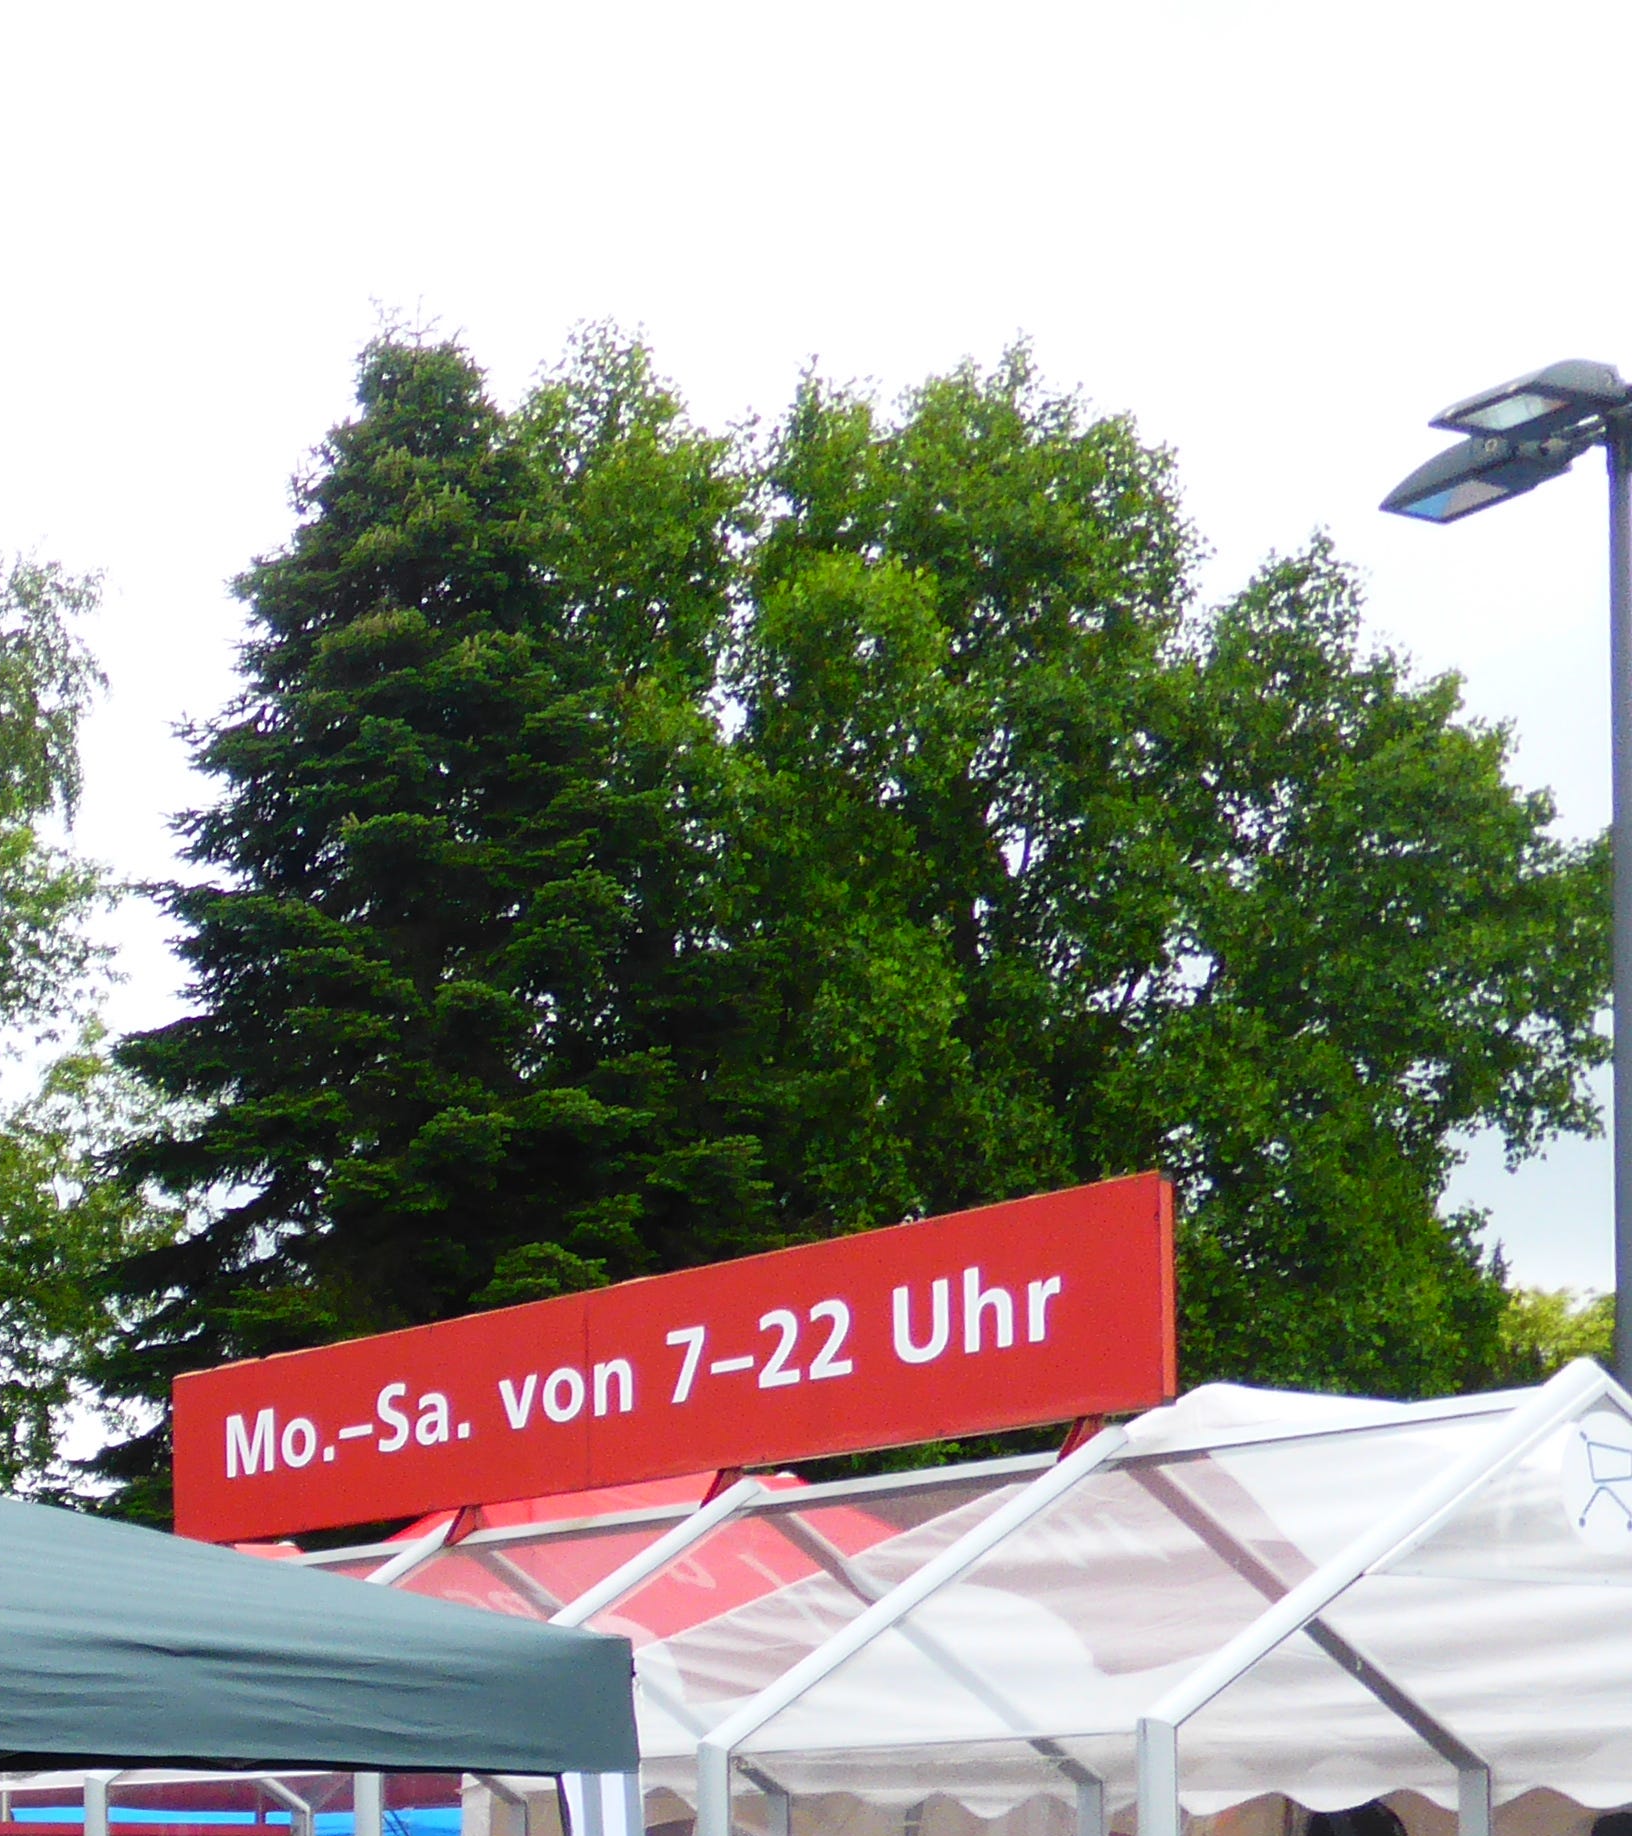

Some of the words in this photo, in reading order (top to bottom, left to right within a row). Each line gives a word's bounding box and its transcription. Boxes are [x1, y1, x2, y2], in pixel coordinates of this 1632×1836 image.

[225, 1382, 471, 1479] Mo.–Sa.
[499, 1356, 635, 1430] von
[666, 1298, 854, 1404] 7–22
[892, 1266, 1064, 1364] Uhr
